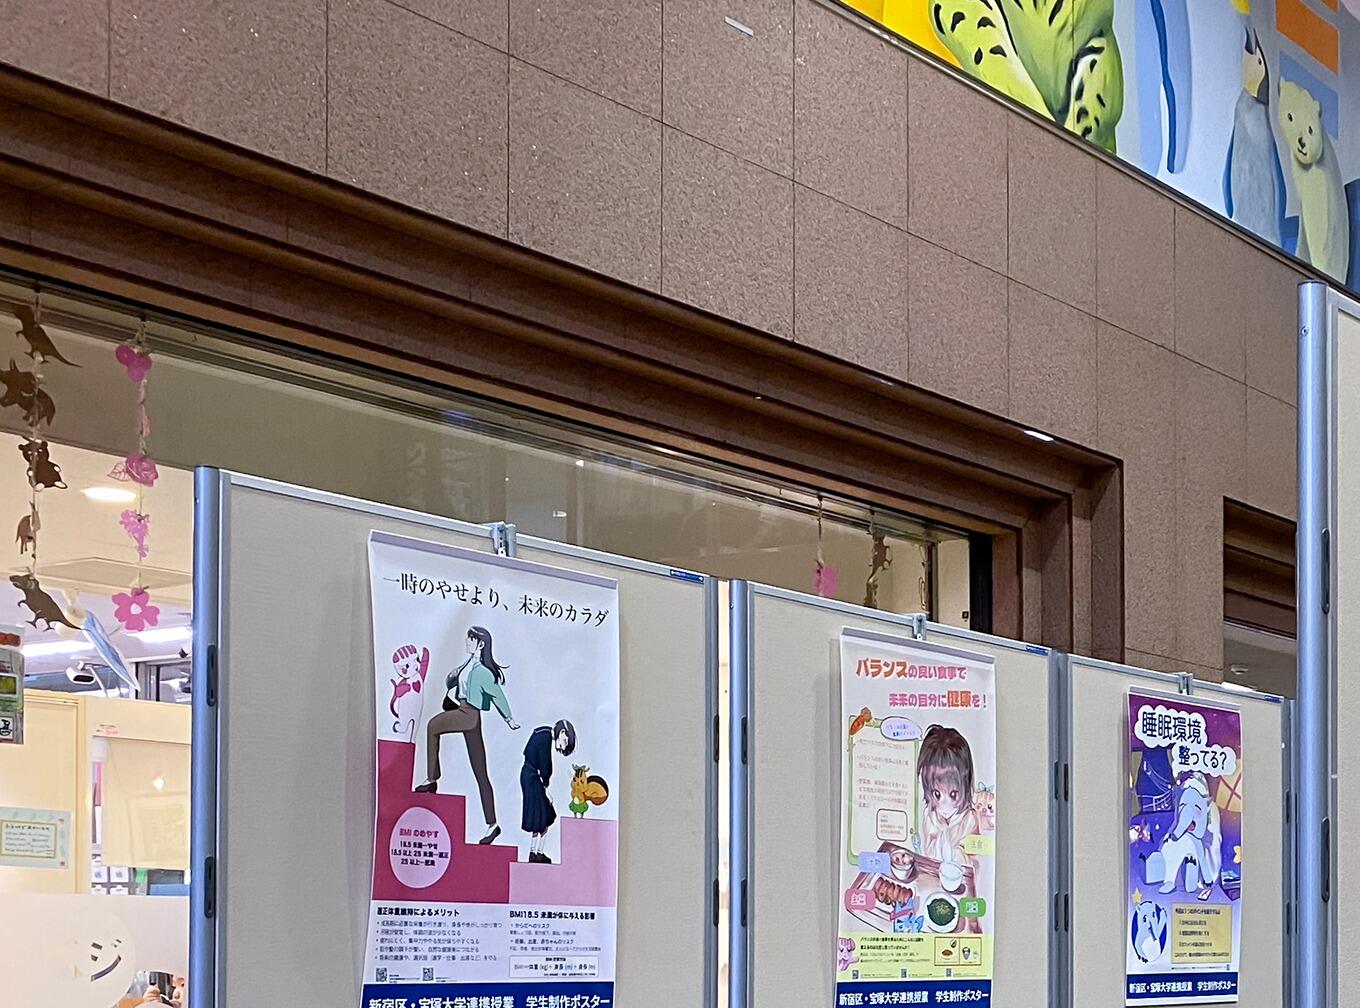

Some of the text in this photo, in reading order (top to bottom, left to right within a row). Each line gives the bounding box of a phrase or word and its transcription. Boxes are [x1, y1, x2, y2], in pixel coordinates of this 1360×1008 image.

[383, 573, 609, 627] 一時のやせより、未来のカラダ
[855, 658, 967, 680] バランスの良い食事で
[1141, 711, 1202, 744] 睡眠環境
